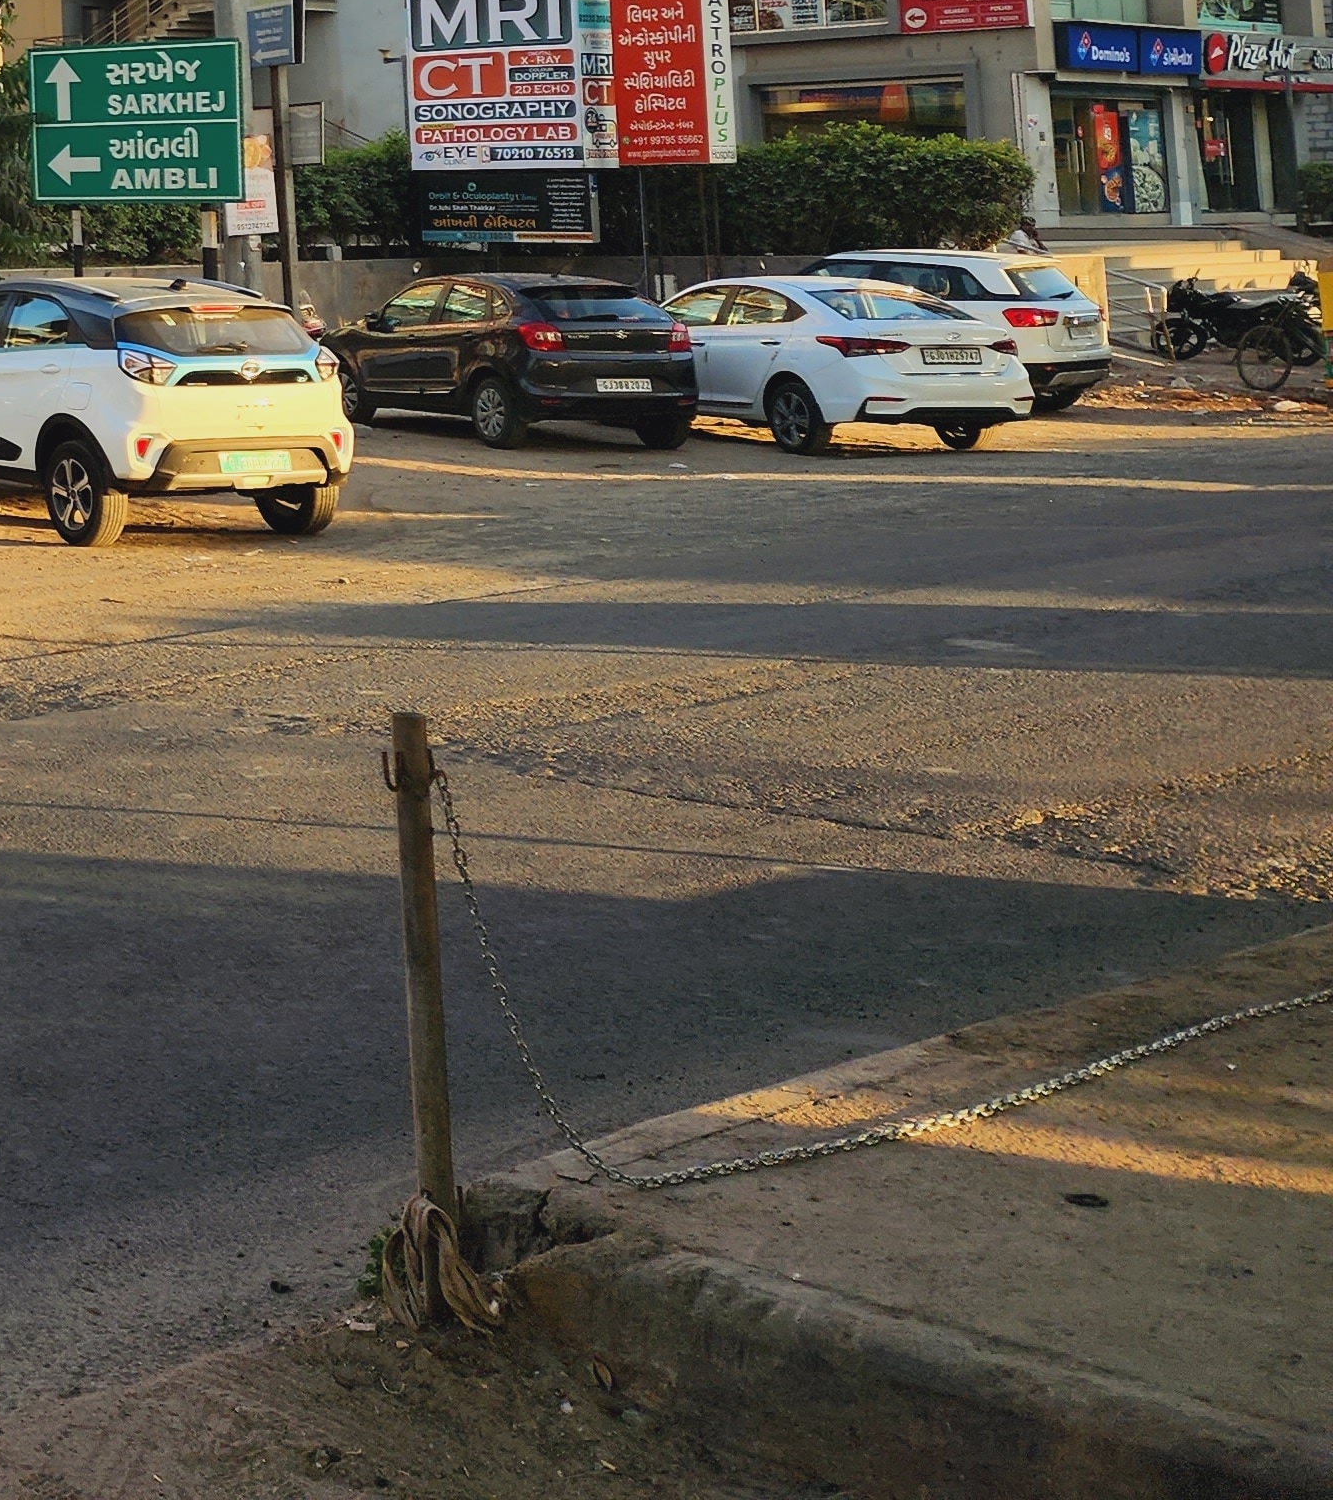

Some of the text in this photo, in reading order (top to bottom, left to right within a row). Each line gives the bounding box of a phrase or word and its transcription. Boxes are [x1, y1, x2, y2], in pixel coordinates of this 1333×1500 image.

[627, 2, 684, 23] લિવર અને
[643, 51, 672, 69] સુપર
[1091, 45, 1131, 63] Domino's
[1228, 34, 1268, 71] Pizza
[1268, 36, 1301, 71] Hut
[105, 51, 202, 85] સરખેજ
[582, 54, 613, 75] MRI
[419, 57, 494, 97] CT
[514, 71, 569, 82] DOPPLER
[514, 83, 570, 95] 2D ECHO
[584, 81, 612, 104] CT
[107, 91, 226, 115] SARKHEJ
[418, 102, 570, 121] SONOGRAPHY
[634, 94, 687, 114] હોસ્પિટલ
[108, 126, 200, 159] આંબલી
[420, 127, 572, 143] PATHOLOGY LAB
[633, 135, 678, 145] +91 99795
[443, 146, 477, 159] EYE
[495, 147, 532, 160] 70210
[536, 147, 575, 160] 76513
[110, 167, 218, 190] AMBLI
[429, 191, 451, 200] Orbit
[462, 191, 515, 202] Oculoplasty
[483, 214, 537, 229] હોસ્પિટલ
